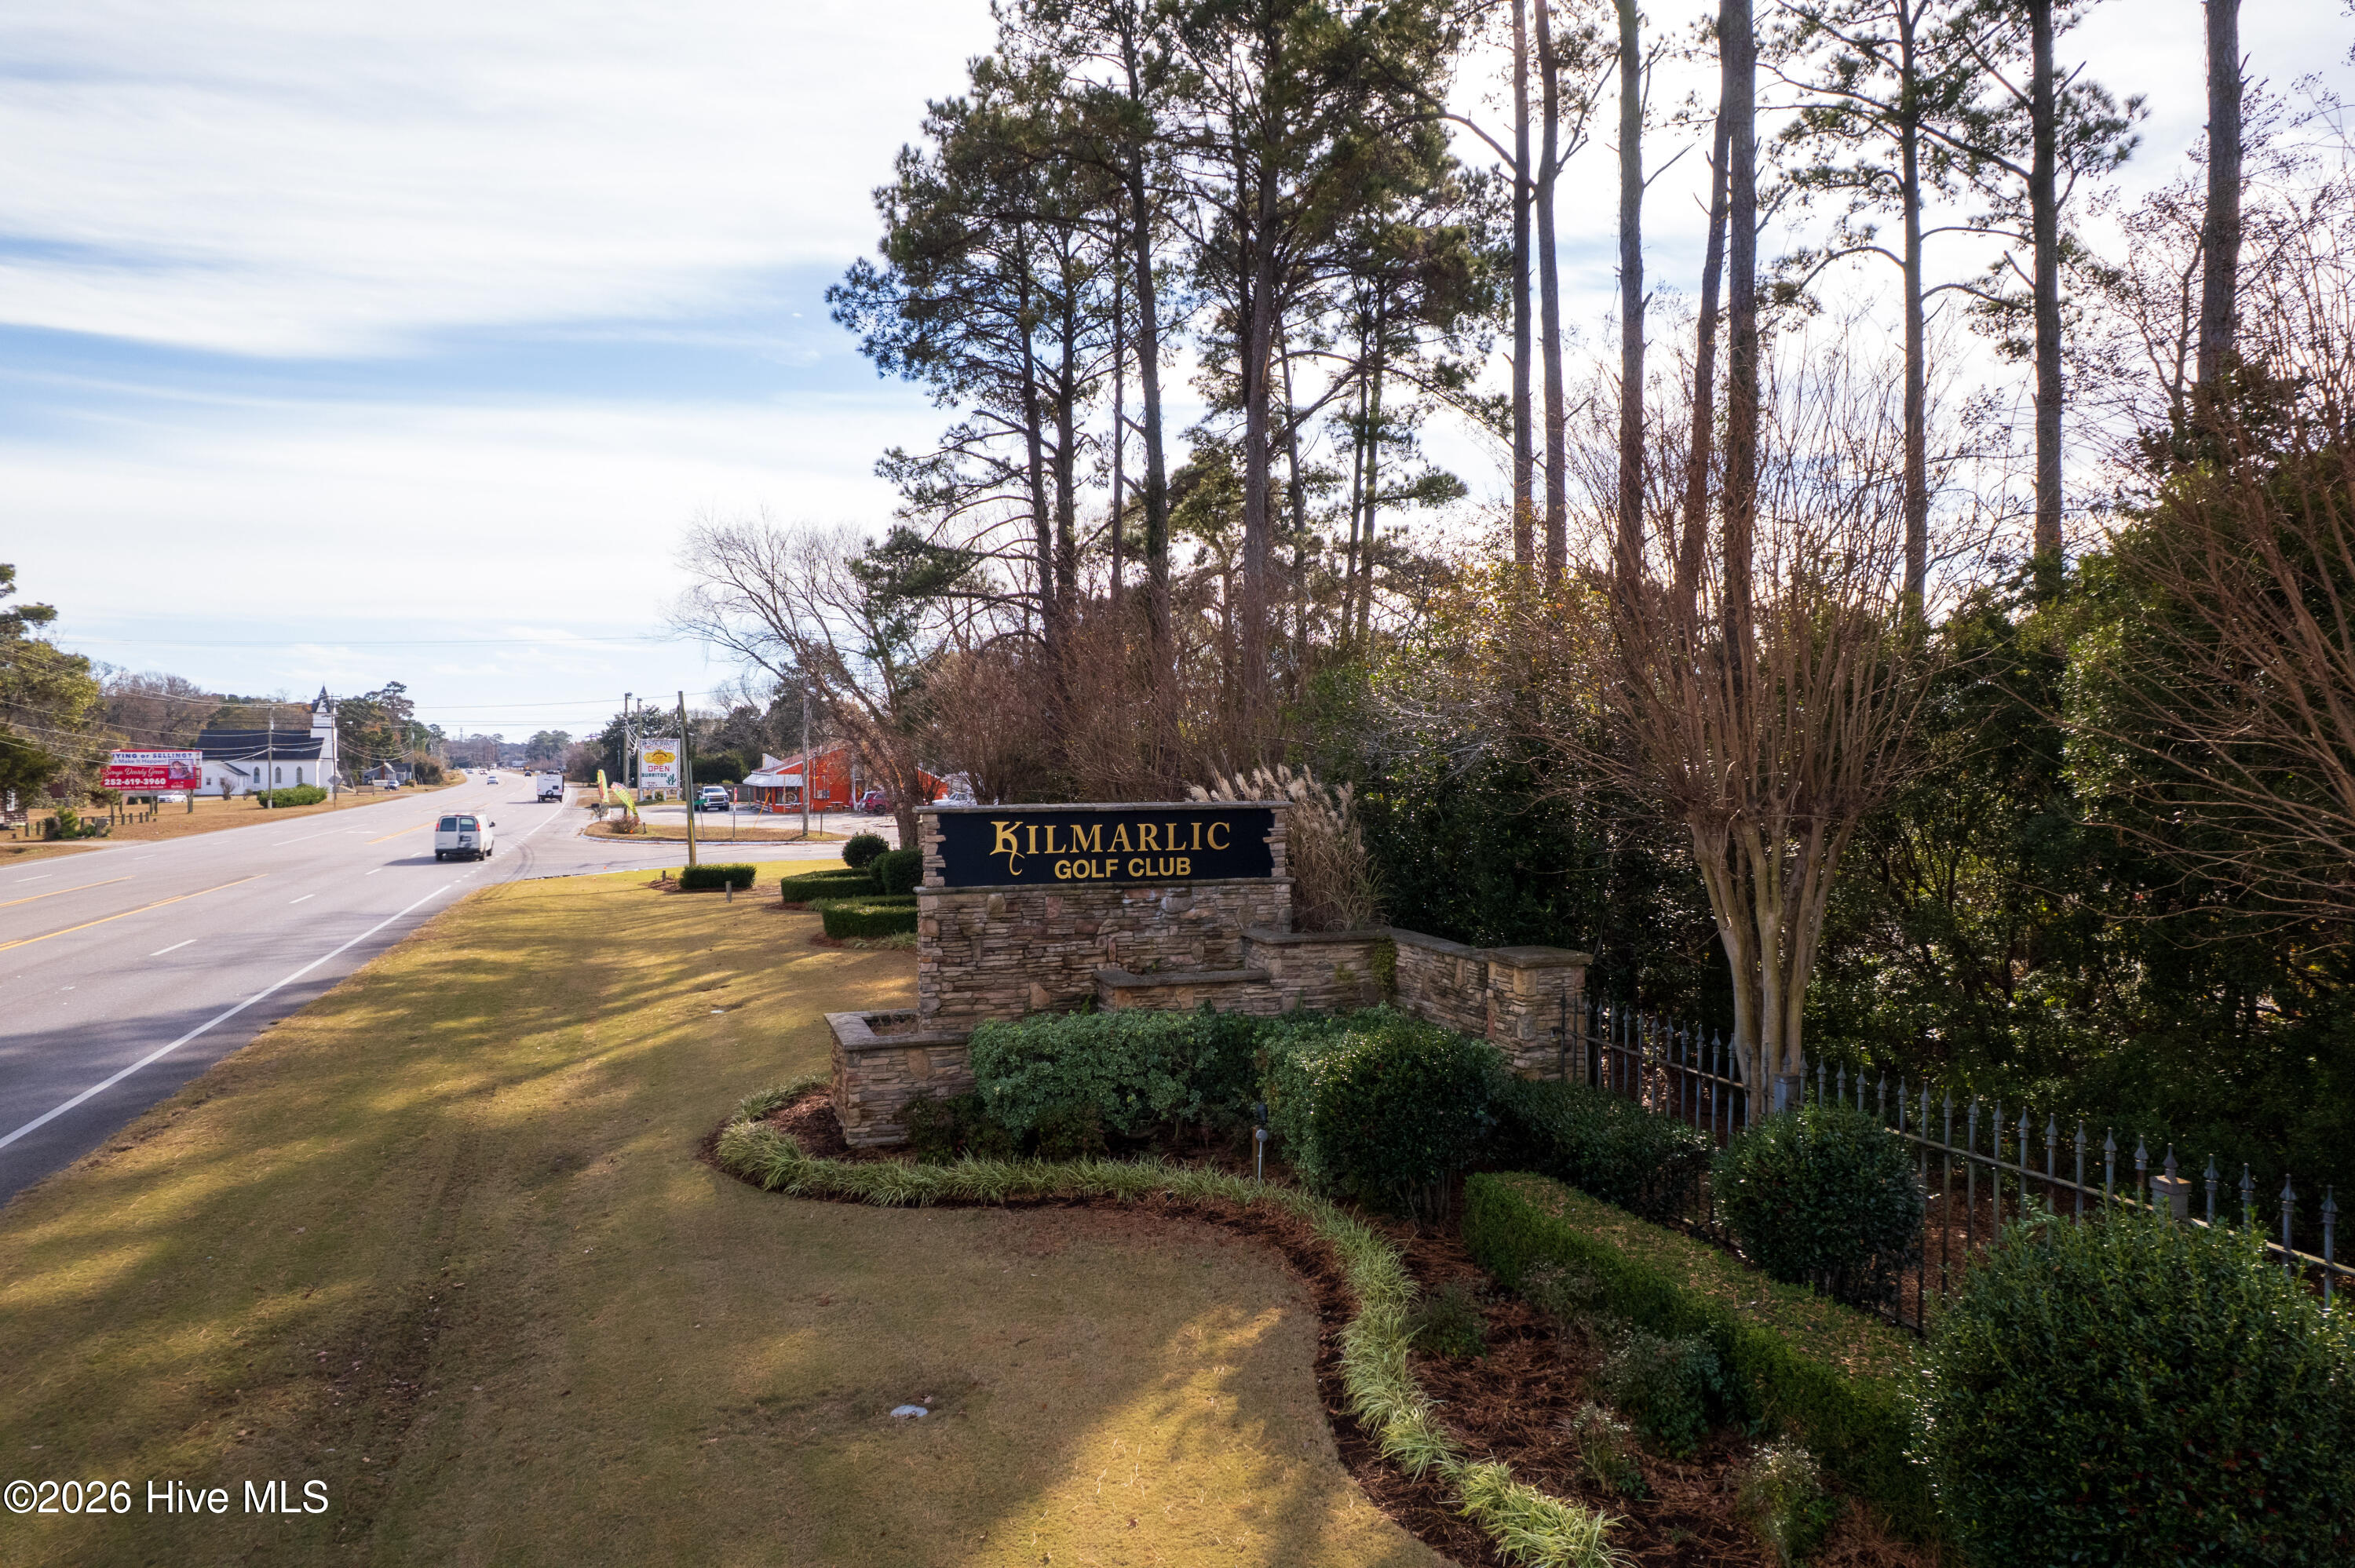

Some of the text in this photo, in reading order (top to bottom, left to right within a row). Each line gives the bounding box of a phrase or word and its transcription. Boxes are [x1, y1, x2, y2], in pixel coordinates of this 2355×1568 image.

[989, 821, 1231, 876] KILMARLIC
[1054, 857, 1192, 879] GOLF CLUB
